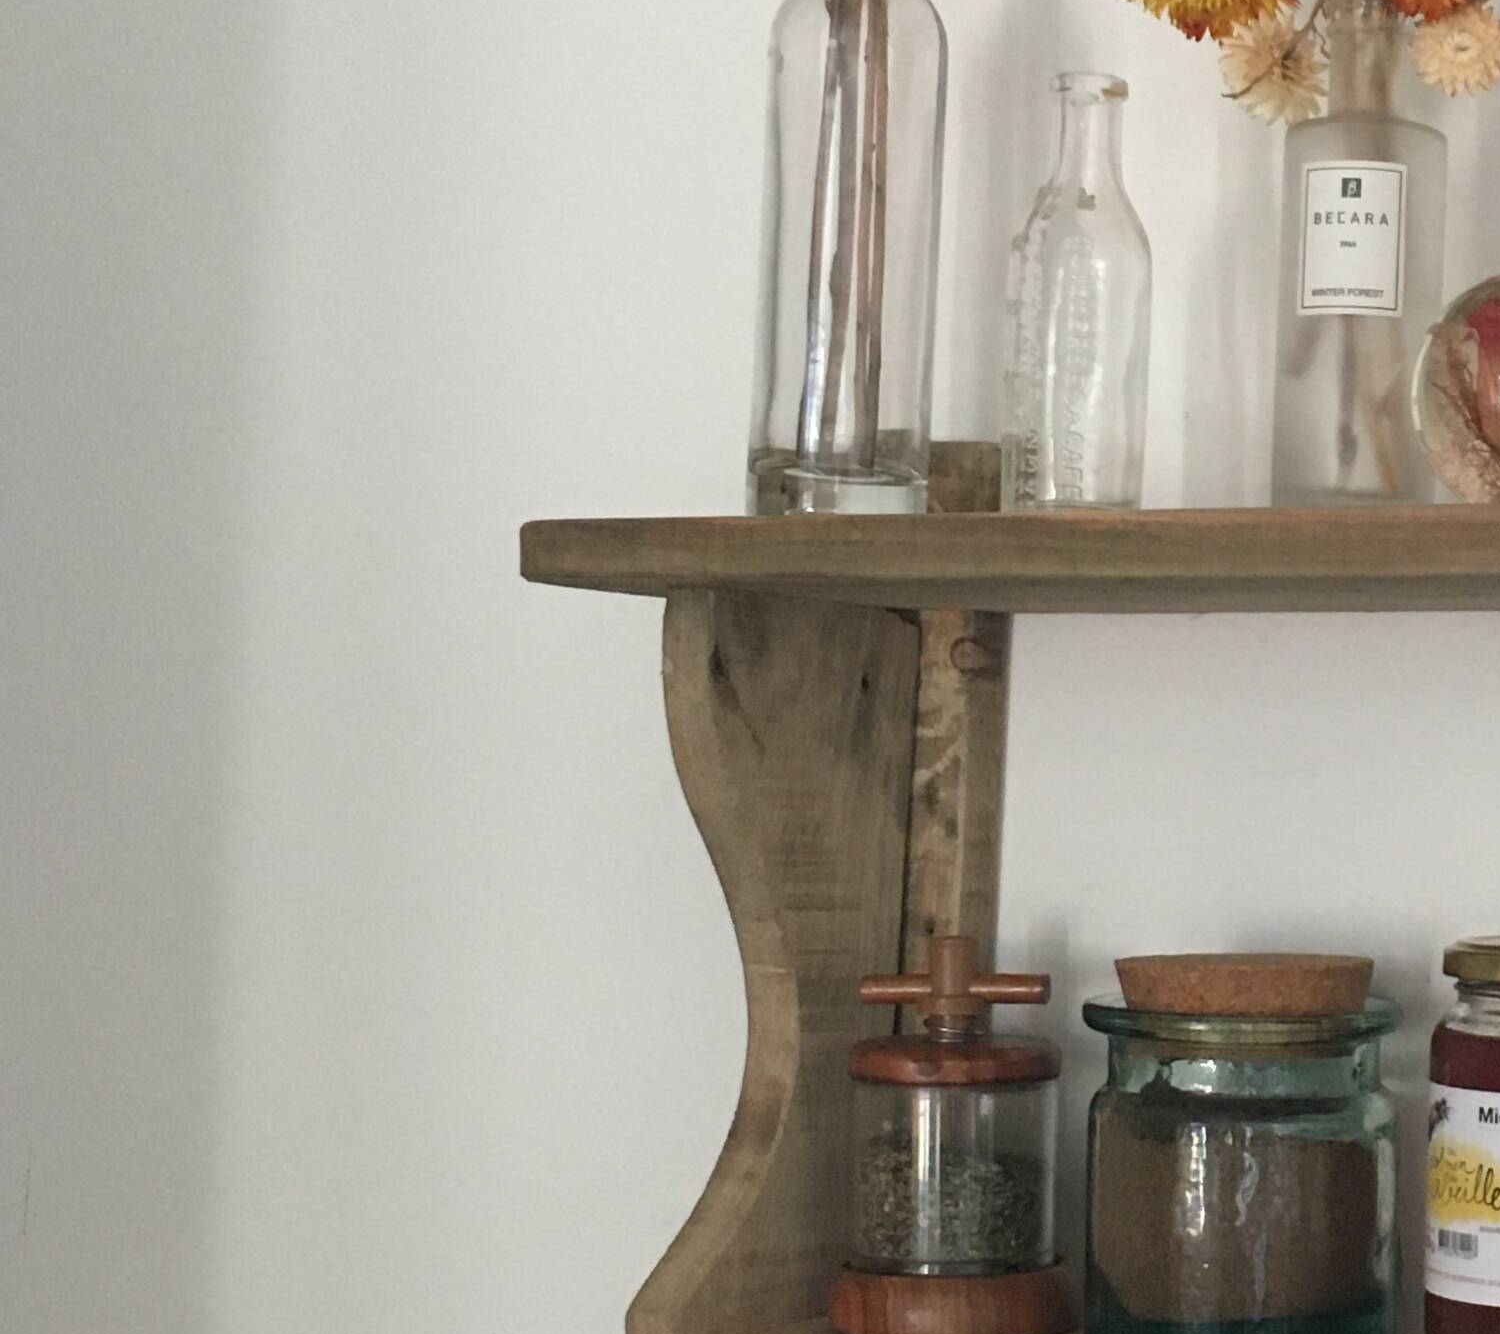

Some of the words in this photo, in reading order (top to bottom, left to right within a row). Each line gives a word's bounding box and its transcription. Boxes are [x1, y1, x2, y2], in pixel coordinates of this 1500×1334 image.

[1313, 211, 1390, 226] BECARA
[1311, 288, 1345, 297] WINTER
[1347, 289, 1385, 298] FOREST
